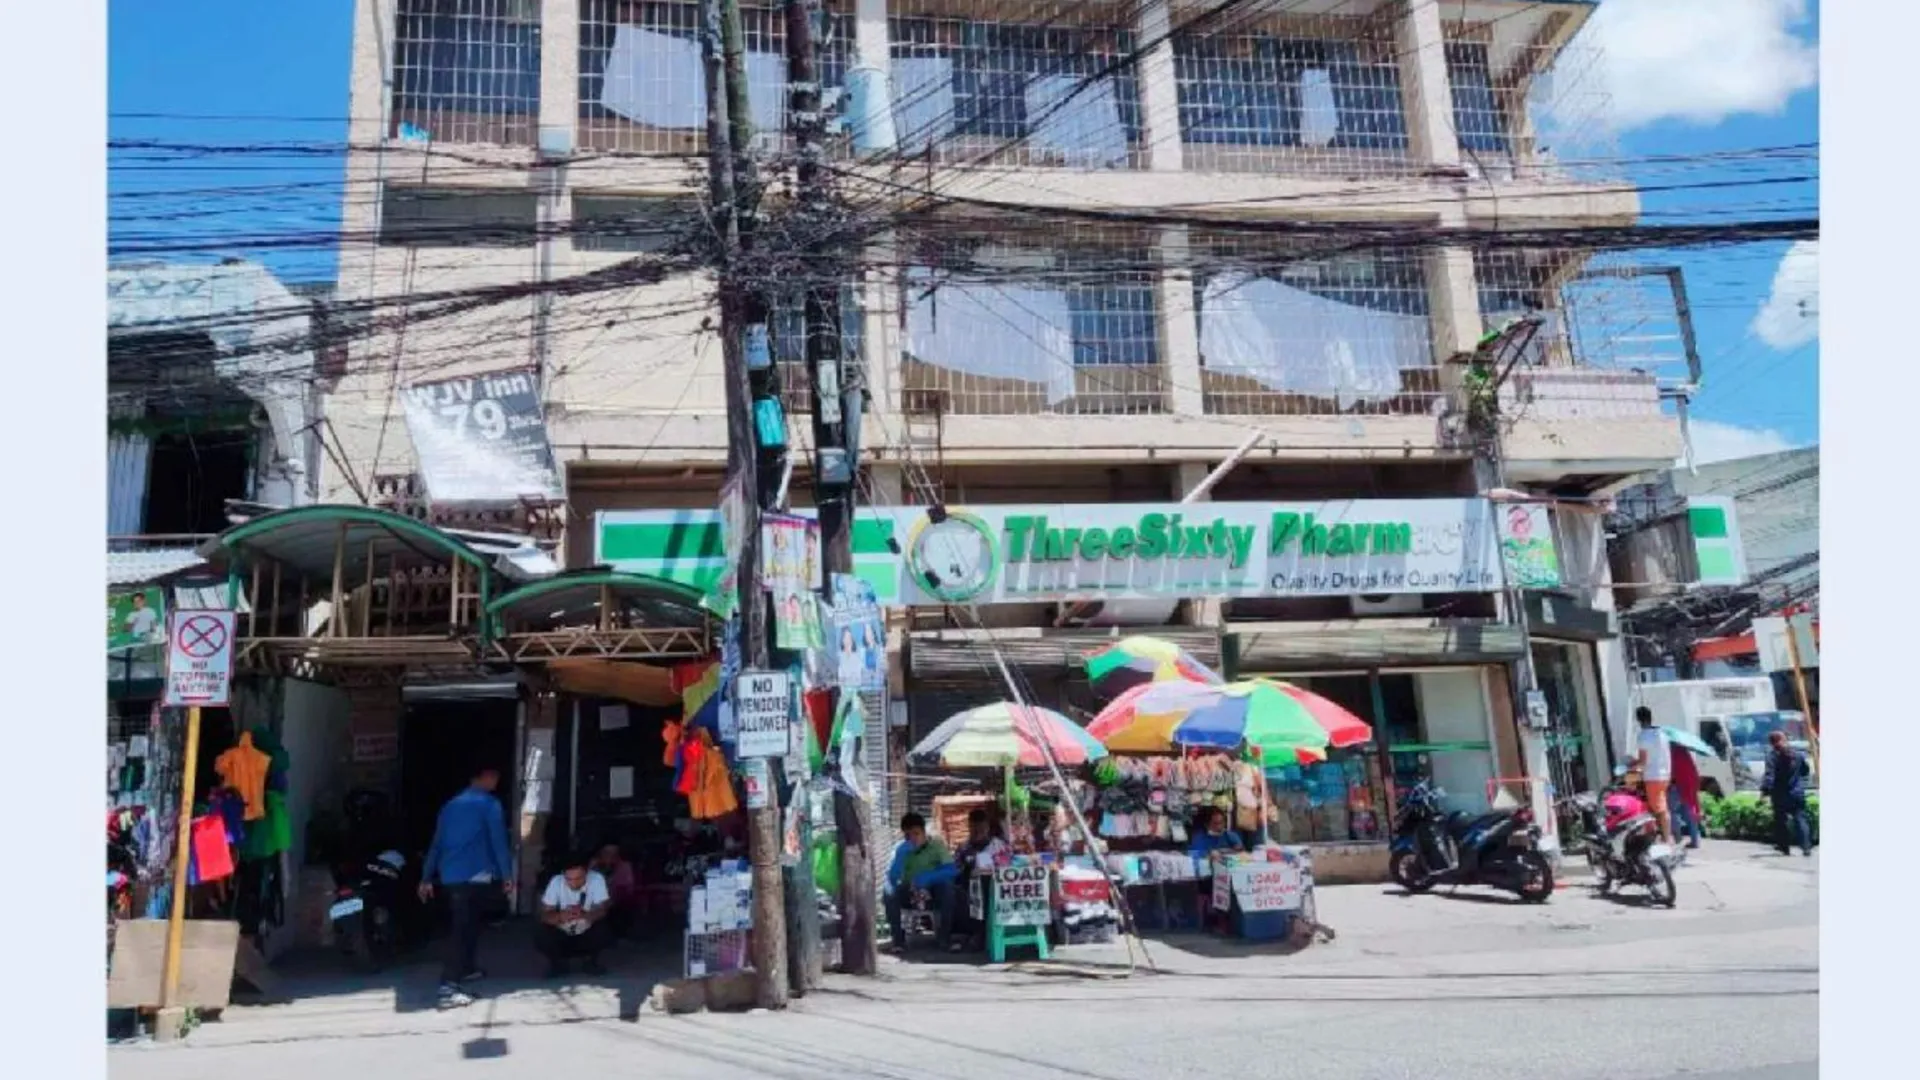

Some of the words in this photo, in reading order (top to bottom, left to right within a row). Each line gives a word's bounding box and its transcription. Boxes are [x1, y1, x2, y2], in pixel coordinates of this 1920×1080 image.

[407, 379, 473, 407] WJV
[439, 399, 507, 441] 79
[1003, 512, 1257, 569] ThreeSixty
[1331, 570, 1379, 590] Drugs
[1382, 569, 1404, 586] for
[1406, 567, 1463, 588] Quality
[751, 677, 773, 693] NO
[740, 715, 789, 732] ALLOWED
[995, 866, 1047, 883] LOAD
[1000, 884, 1045, 899] HERE
